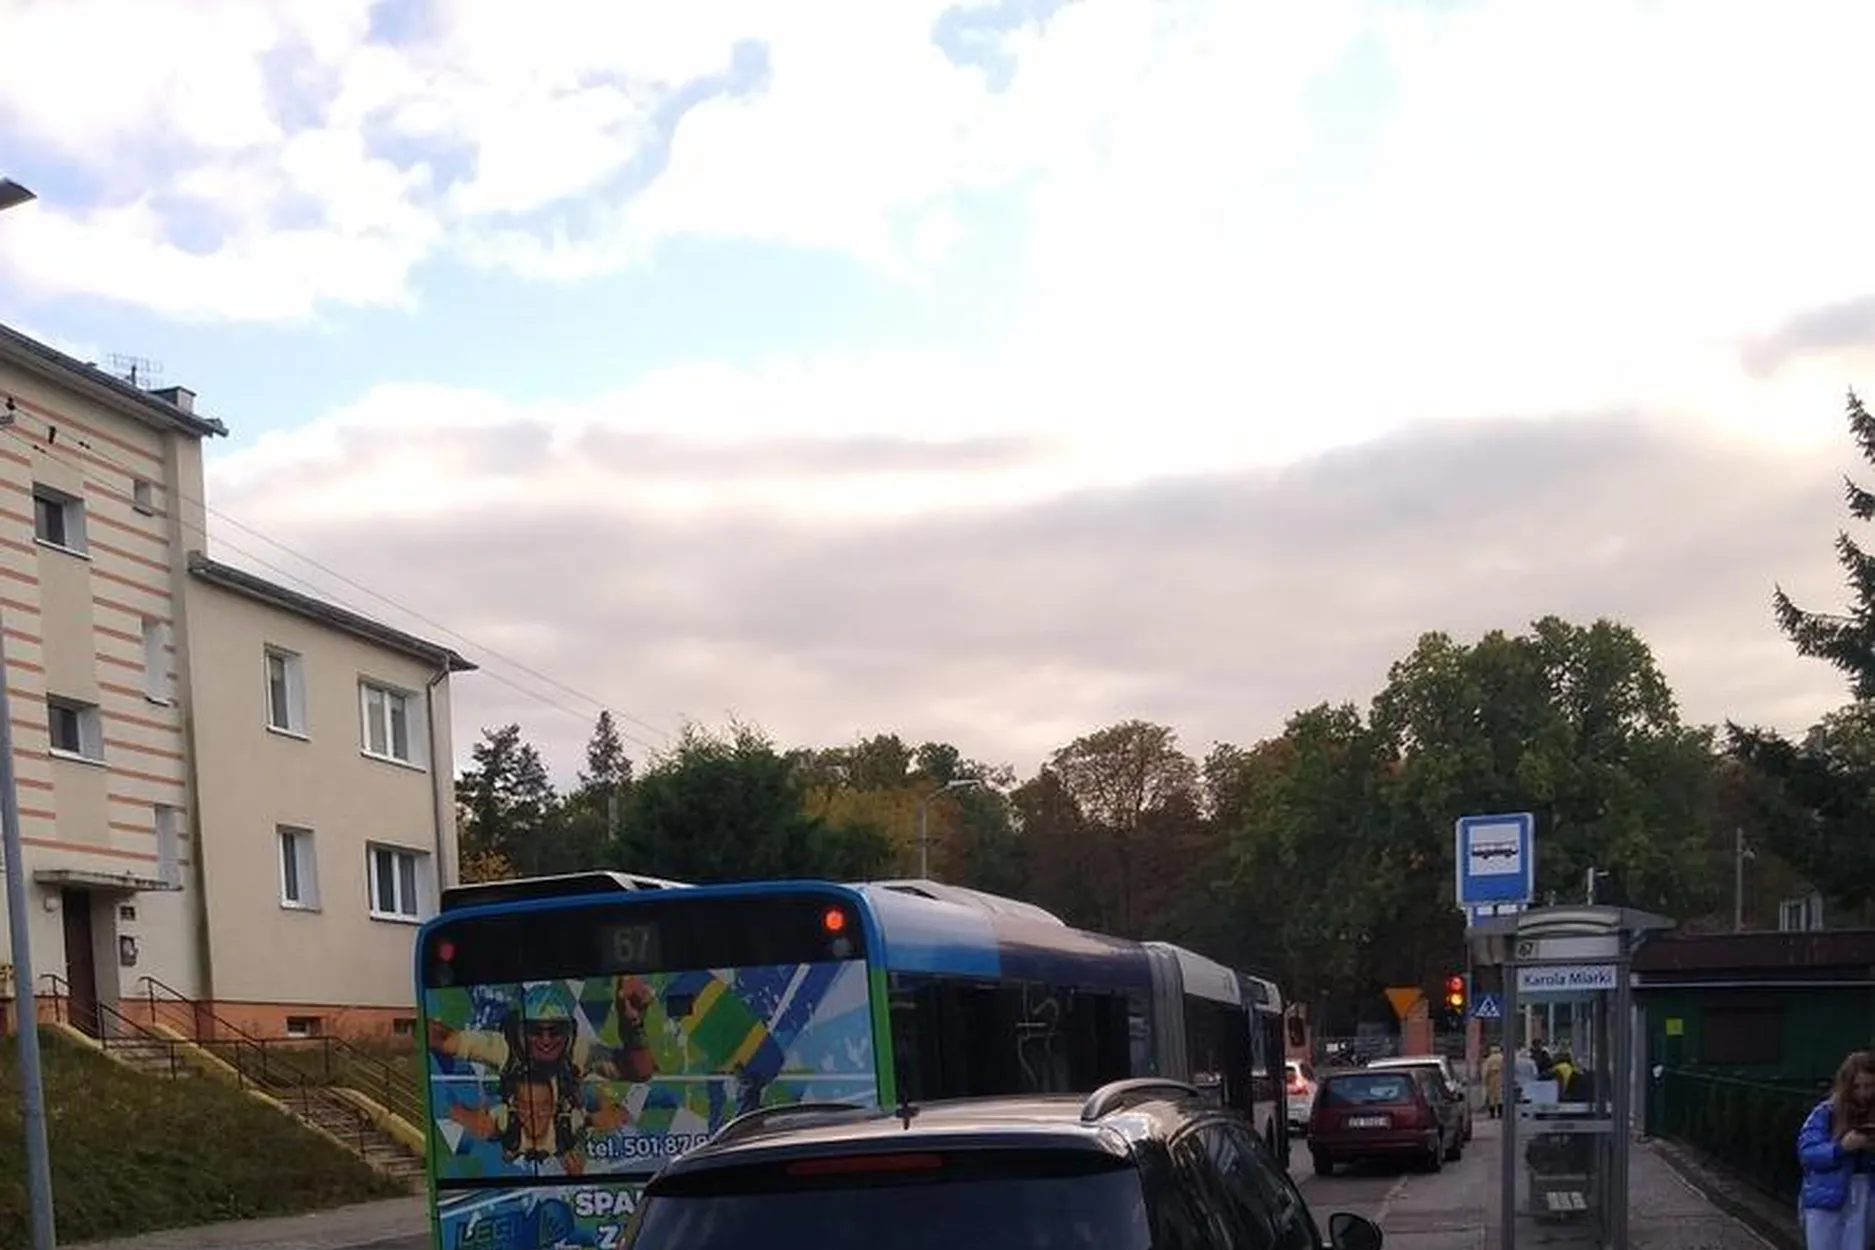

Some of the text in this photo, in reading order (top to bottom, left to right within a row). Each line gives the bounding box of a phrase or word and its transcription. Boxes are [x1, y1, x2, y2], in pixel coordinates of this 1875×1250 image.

[613, 926, 649, 962] 67
[1524, 970, 1611, 986] Karola Miarki
[586, 1138, 619, 1157] tel.
[624, 1136, 659, 1156] 501
[575, 1190, 644, 1217] SPA
